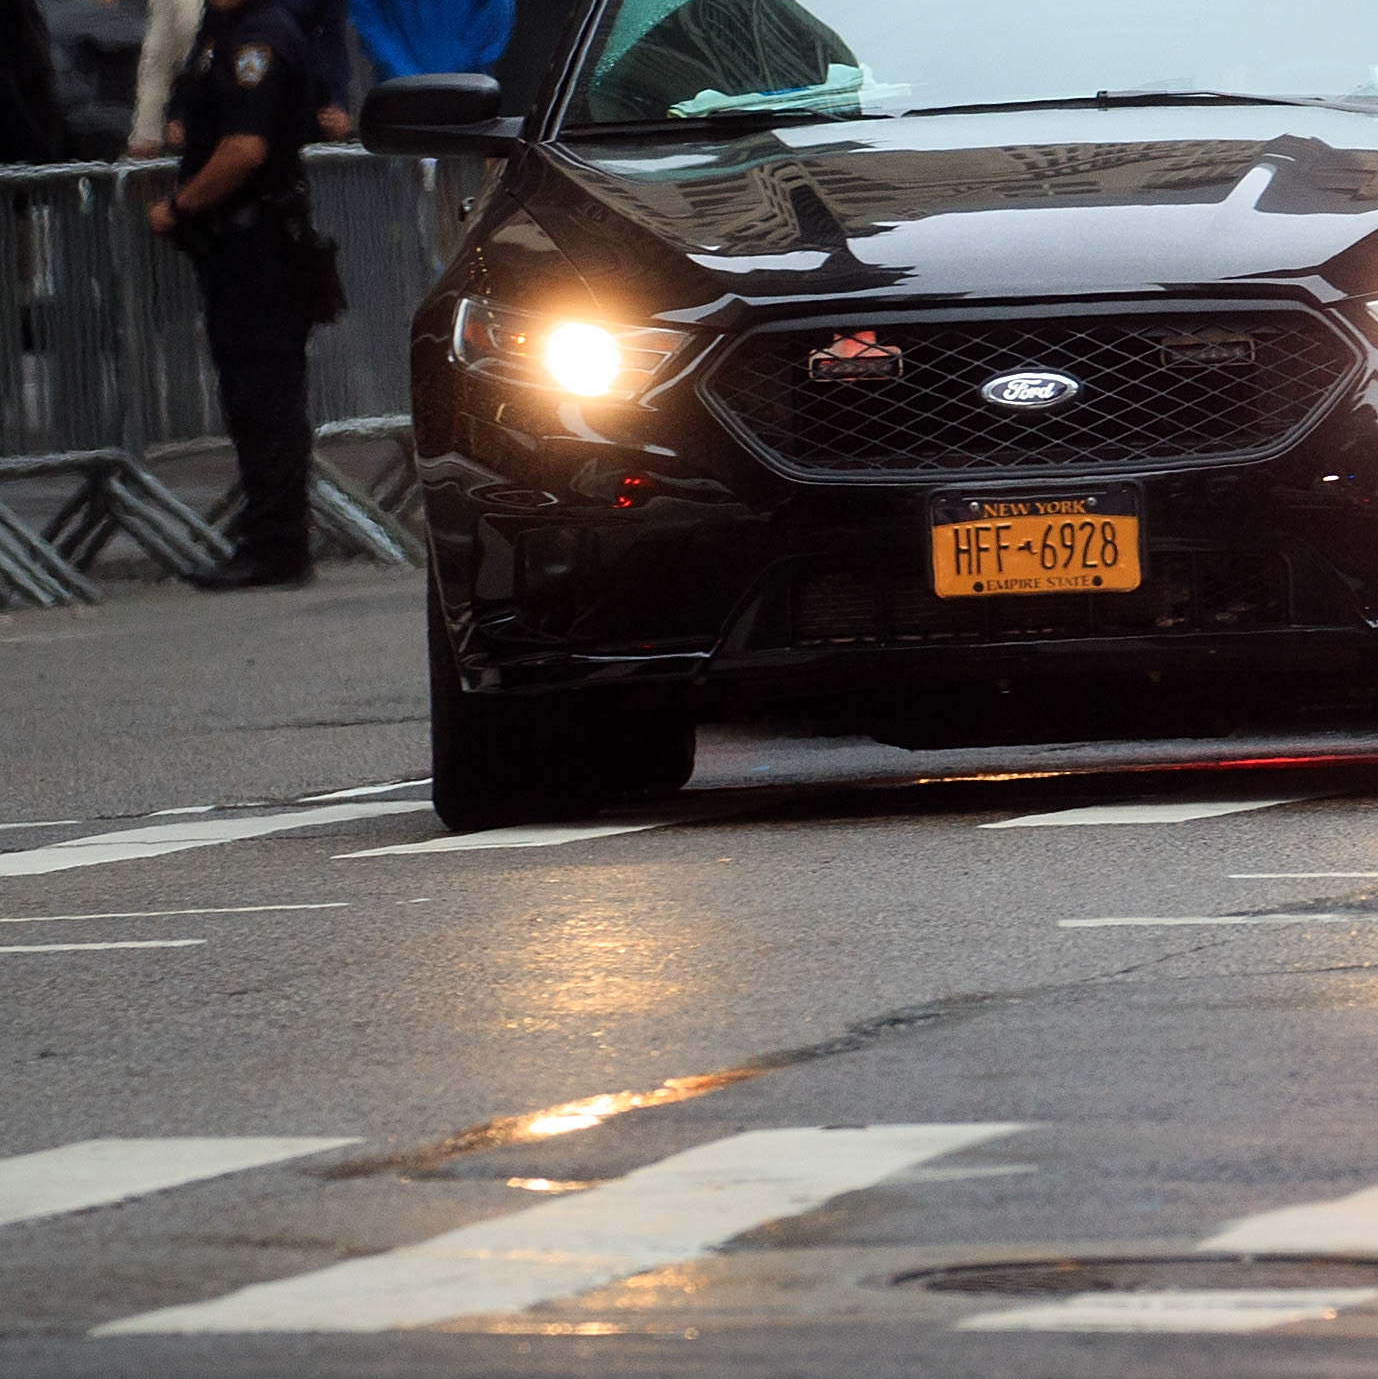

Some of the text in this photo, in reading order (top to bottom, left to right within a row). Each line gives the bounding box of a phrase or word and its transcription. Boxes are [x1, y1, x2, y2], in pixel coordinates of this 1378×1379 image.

[1001, 378, 1057, 400] Ford
[983, 500, 1087, 518] NEW YORK
[986, 574, 1090, 592] EMPIRE STATE
